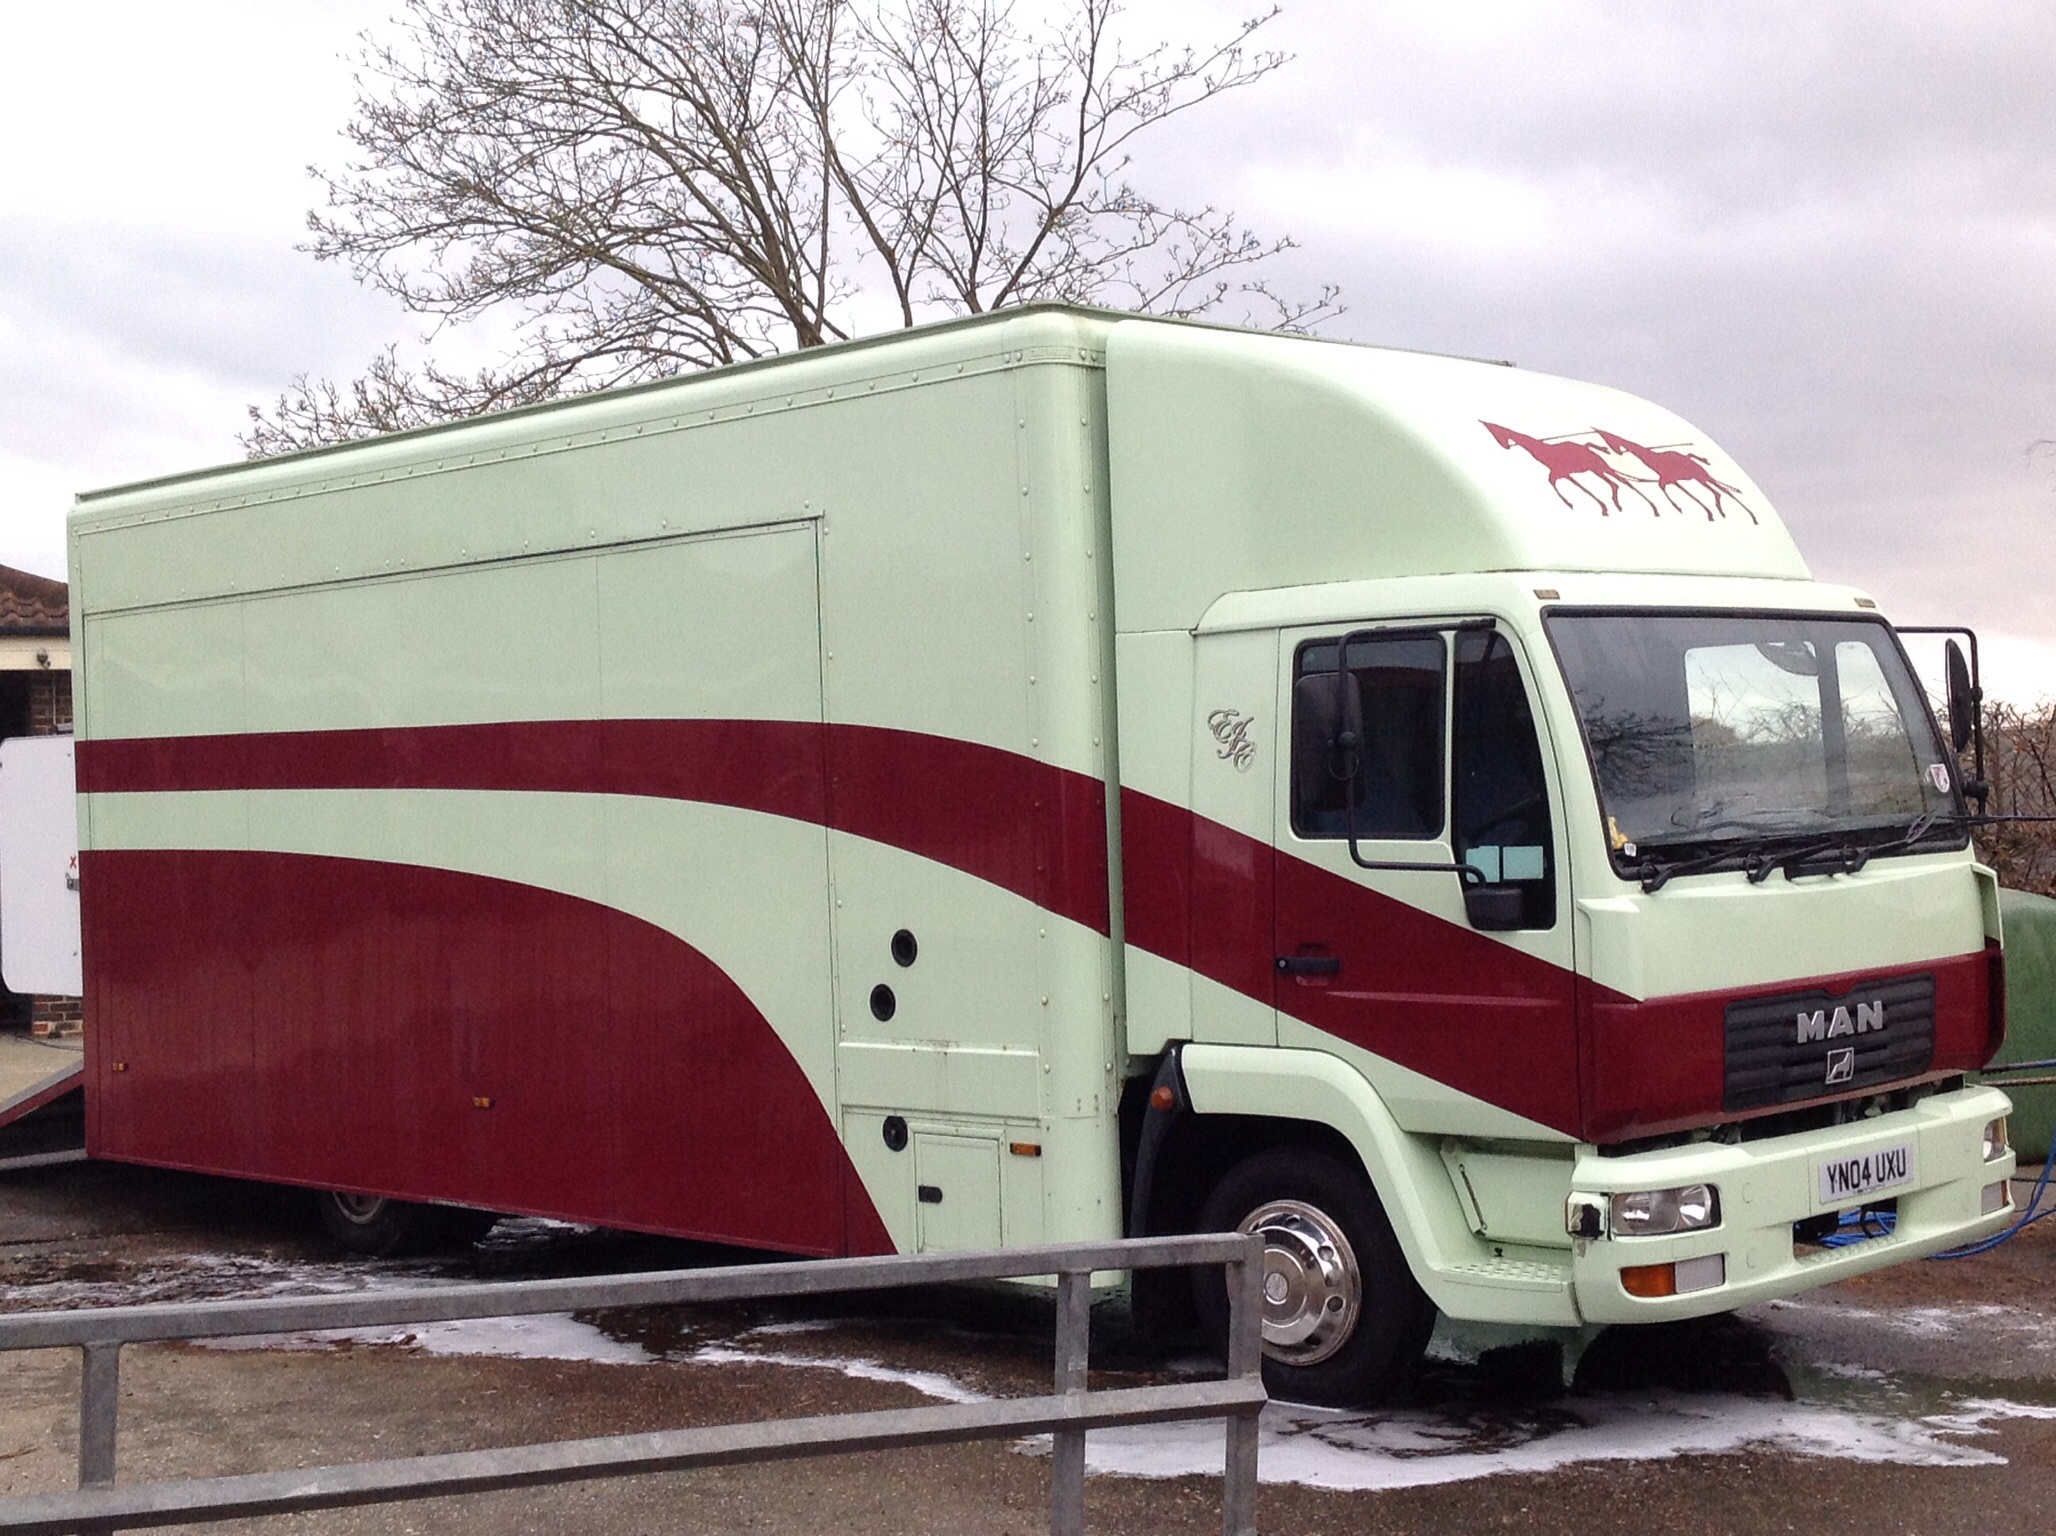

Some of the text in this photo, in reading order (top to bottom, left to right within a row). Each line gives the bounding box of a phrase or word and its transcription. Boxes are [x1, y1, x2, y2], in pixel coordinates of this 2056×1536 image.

[1797, 1000, 1883, 1044] MAN
[1827, 1148, 1906, 1194] YN04 UXU
